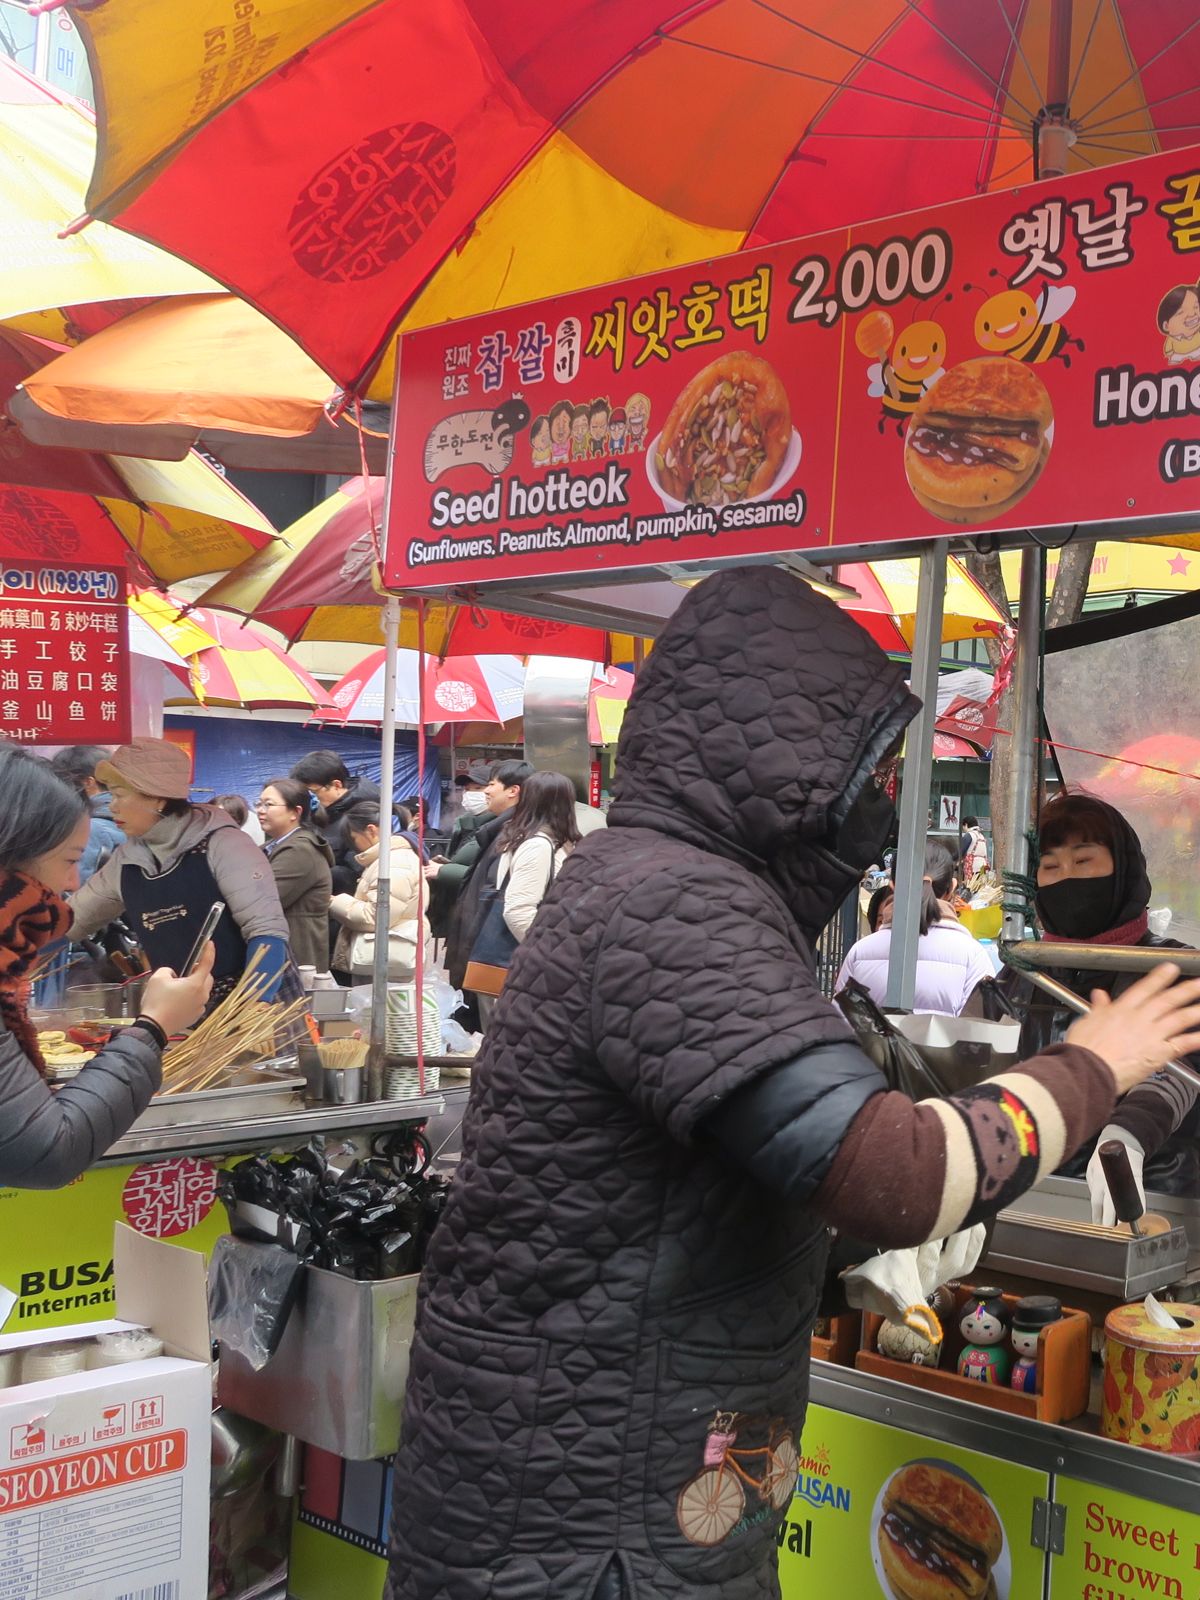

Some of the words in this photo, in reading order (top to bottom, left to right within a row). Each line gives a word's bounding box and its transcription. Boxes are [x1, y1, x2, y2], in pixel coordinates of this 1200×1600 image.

[1003, 187, 1144, 284] 옛날
[584, 267, 771, 371] 씨앗호떡
[793, 233, 946, 323] 2,000
[444, 344, 472, 372] 진짜
[475, 322, 553, 392] 찹쌀
[556, 319, 578, 379] 흑미
[442, 373, 470, 400] 원조
[436, 429, 495, 456] 무한도전
[432, 483, 501, 527] Seed
[509, 465, 628, 517] hotteok
[635, 508, 719, 542] pumpkin,
[722, 494, 804, 528] sesame)
[38, 568, 119, 600] (1986년)
[0, 638, 119, 663] 手工饺子
[0, 669, 119, 692] 油豆腐口袋
[2, 700, 118, 722] 釜山鱼饼
[19, 1285, 116, 1318] Internati
[0, 1450, 118, 1506] SEOYEON
[125, 1438, 175, 1476] CUP
[793, 1473, 850, 1512] USAN
[1085, 1502, 1180, 1557] Sweet
[1083, 1541, 1184, 1600] brown
